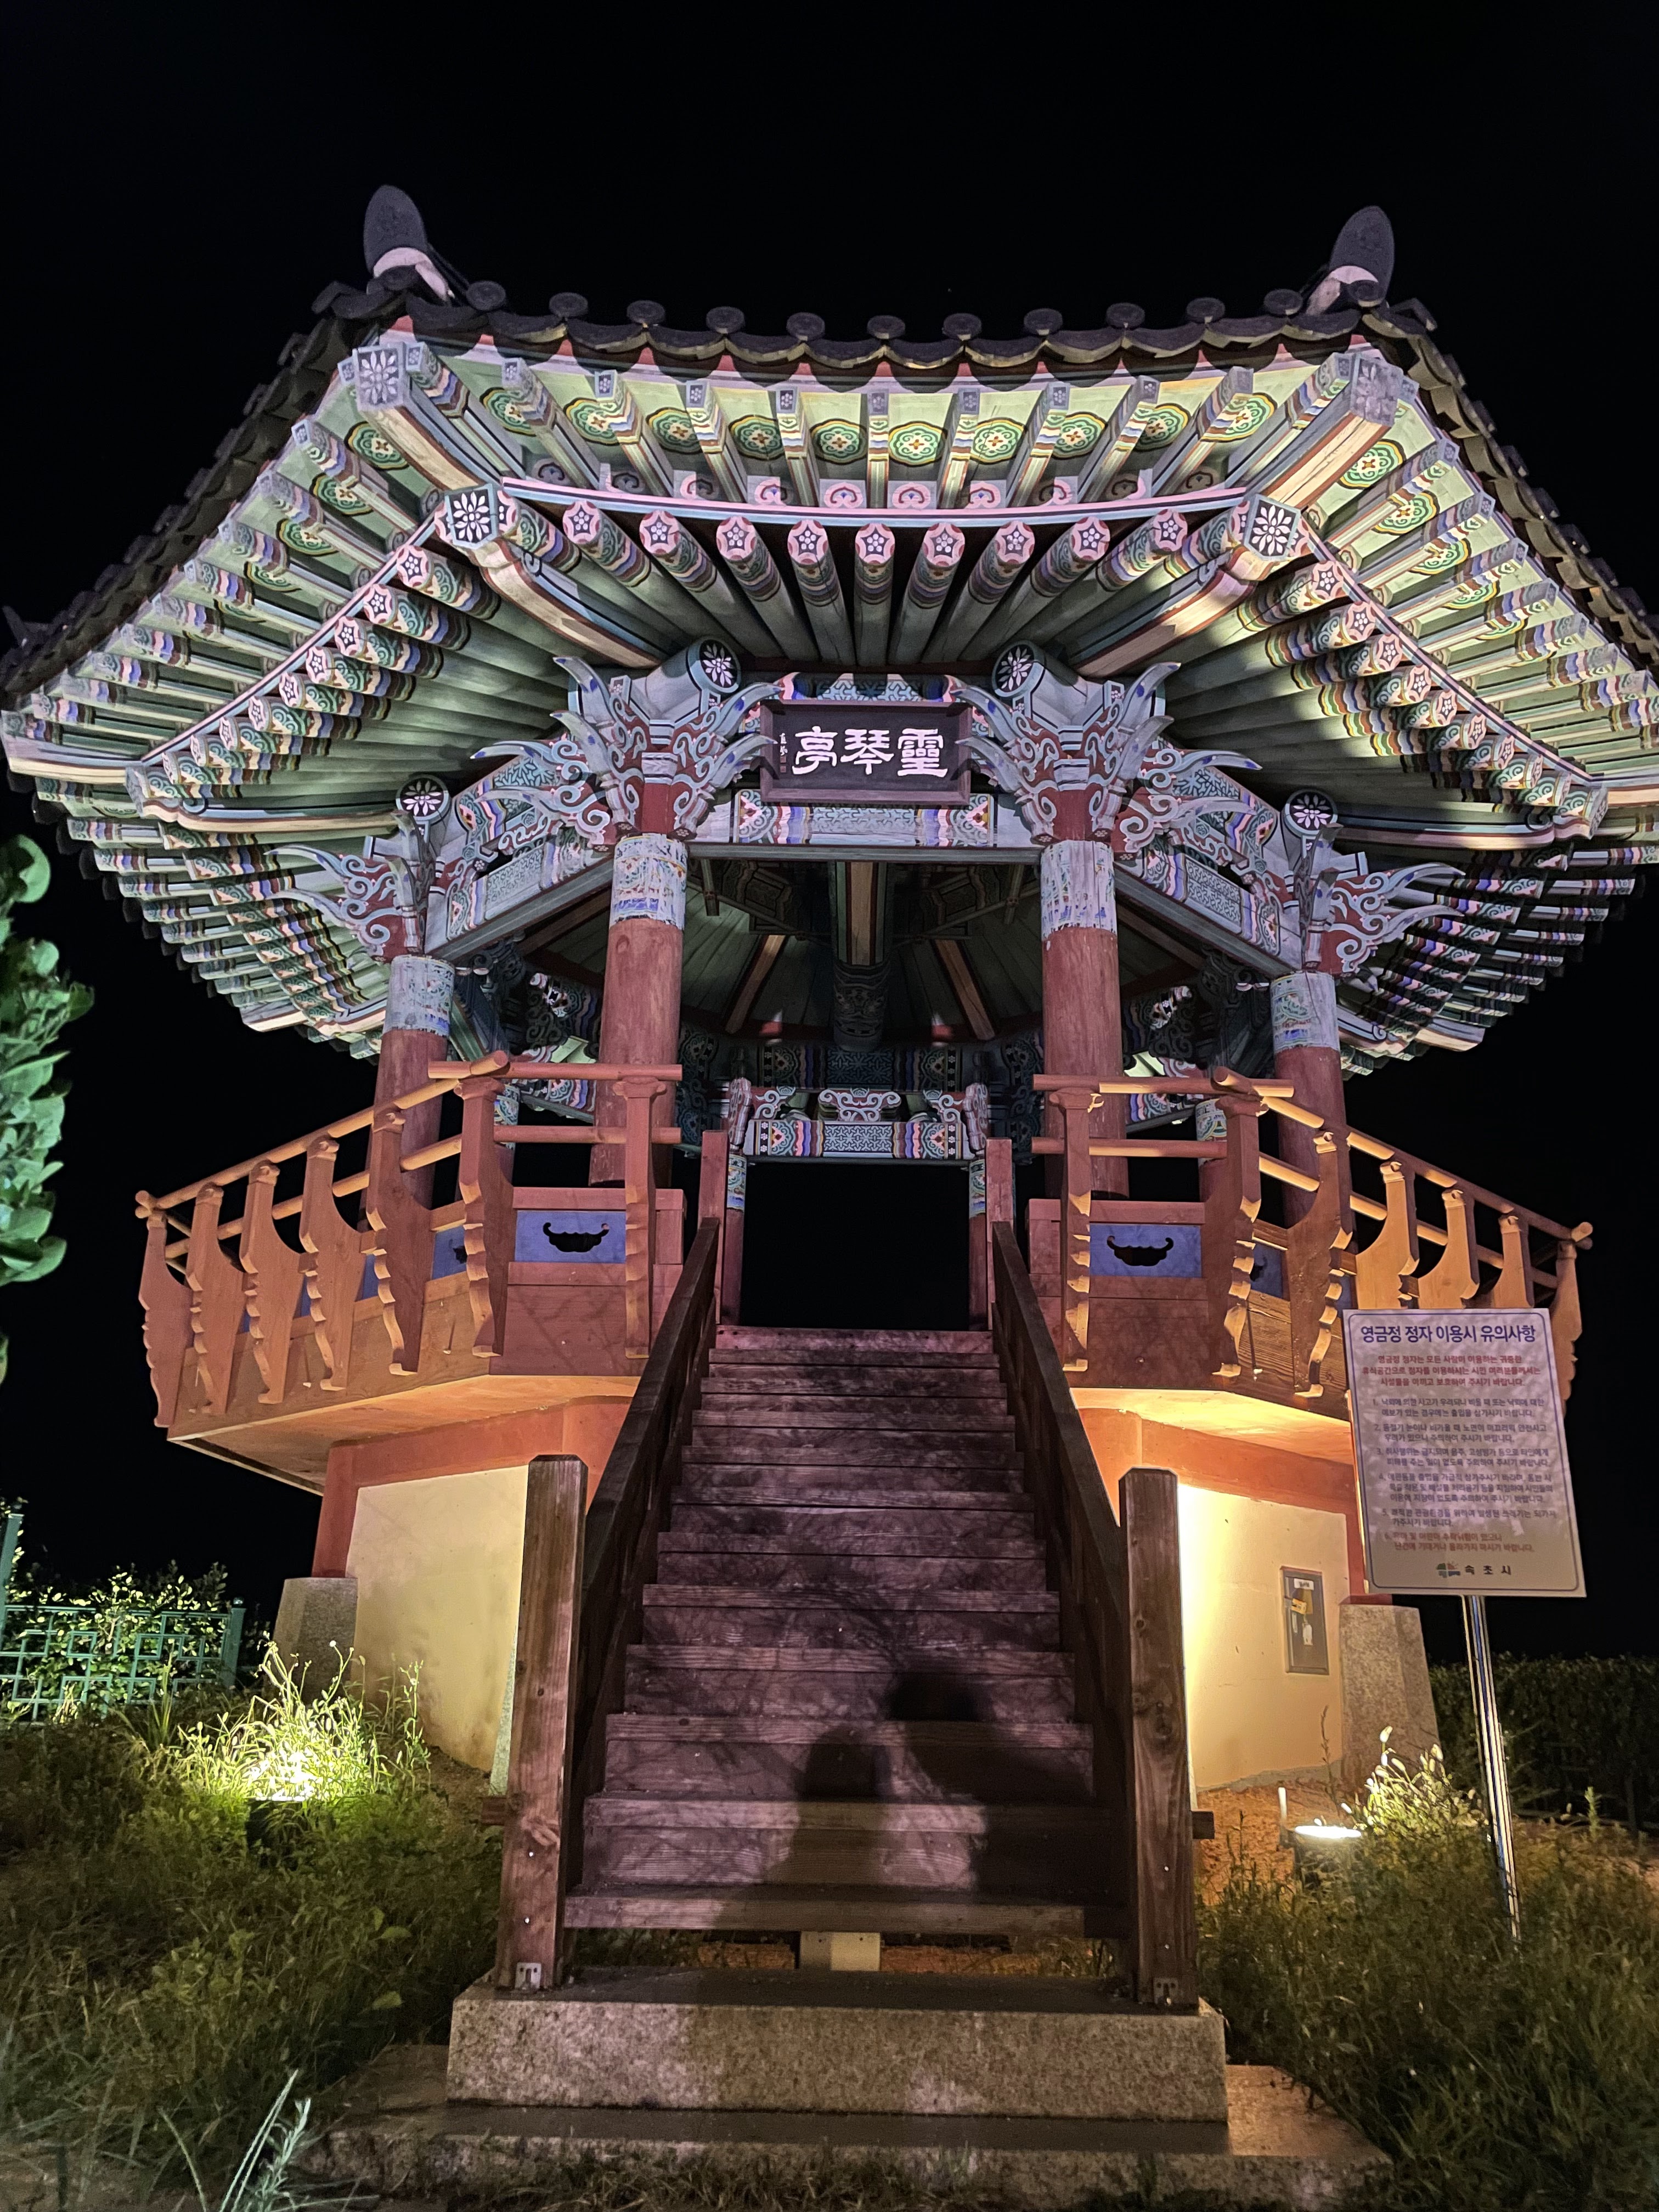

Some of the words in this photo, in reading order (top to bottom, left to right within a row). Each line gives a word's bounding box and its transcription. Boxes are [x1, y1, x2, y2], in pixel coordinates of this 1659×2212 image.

[1361, 1326, 1402, 1342] 영금정
[1405, 1326, 1432, 1342] 정자
[1436, 1326, 1477, 1342] 이용시
[1480, 1326, 1536, 1342] 유의사항
[1378, 1356, 1400, 1364] 영금정
[1403, 1356, 1424, 1364] 정자는
[1426, 1356, 1441, 1364] 모든
[1468, 1378, 1491, 1386] 주시기
